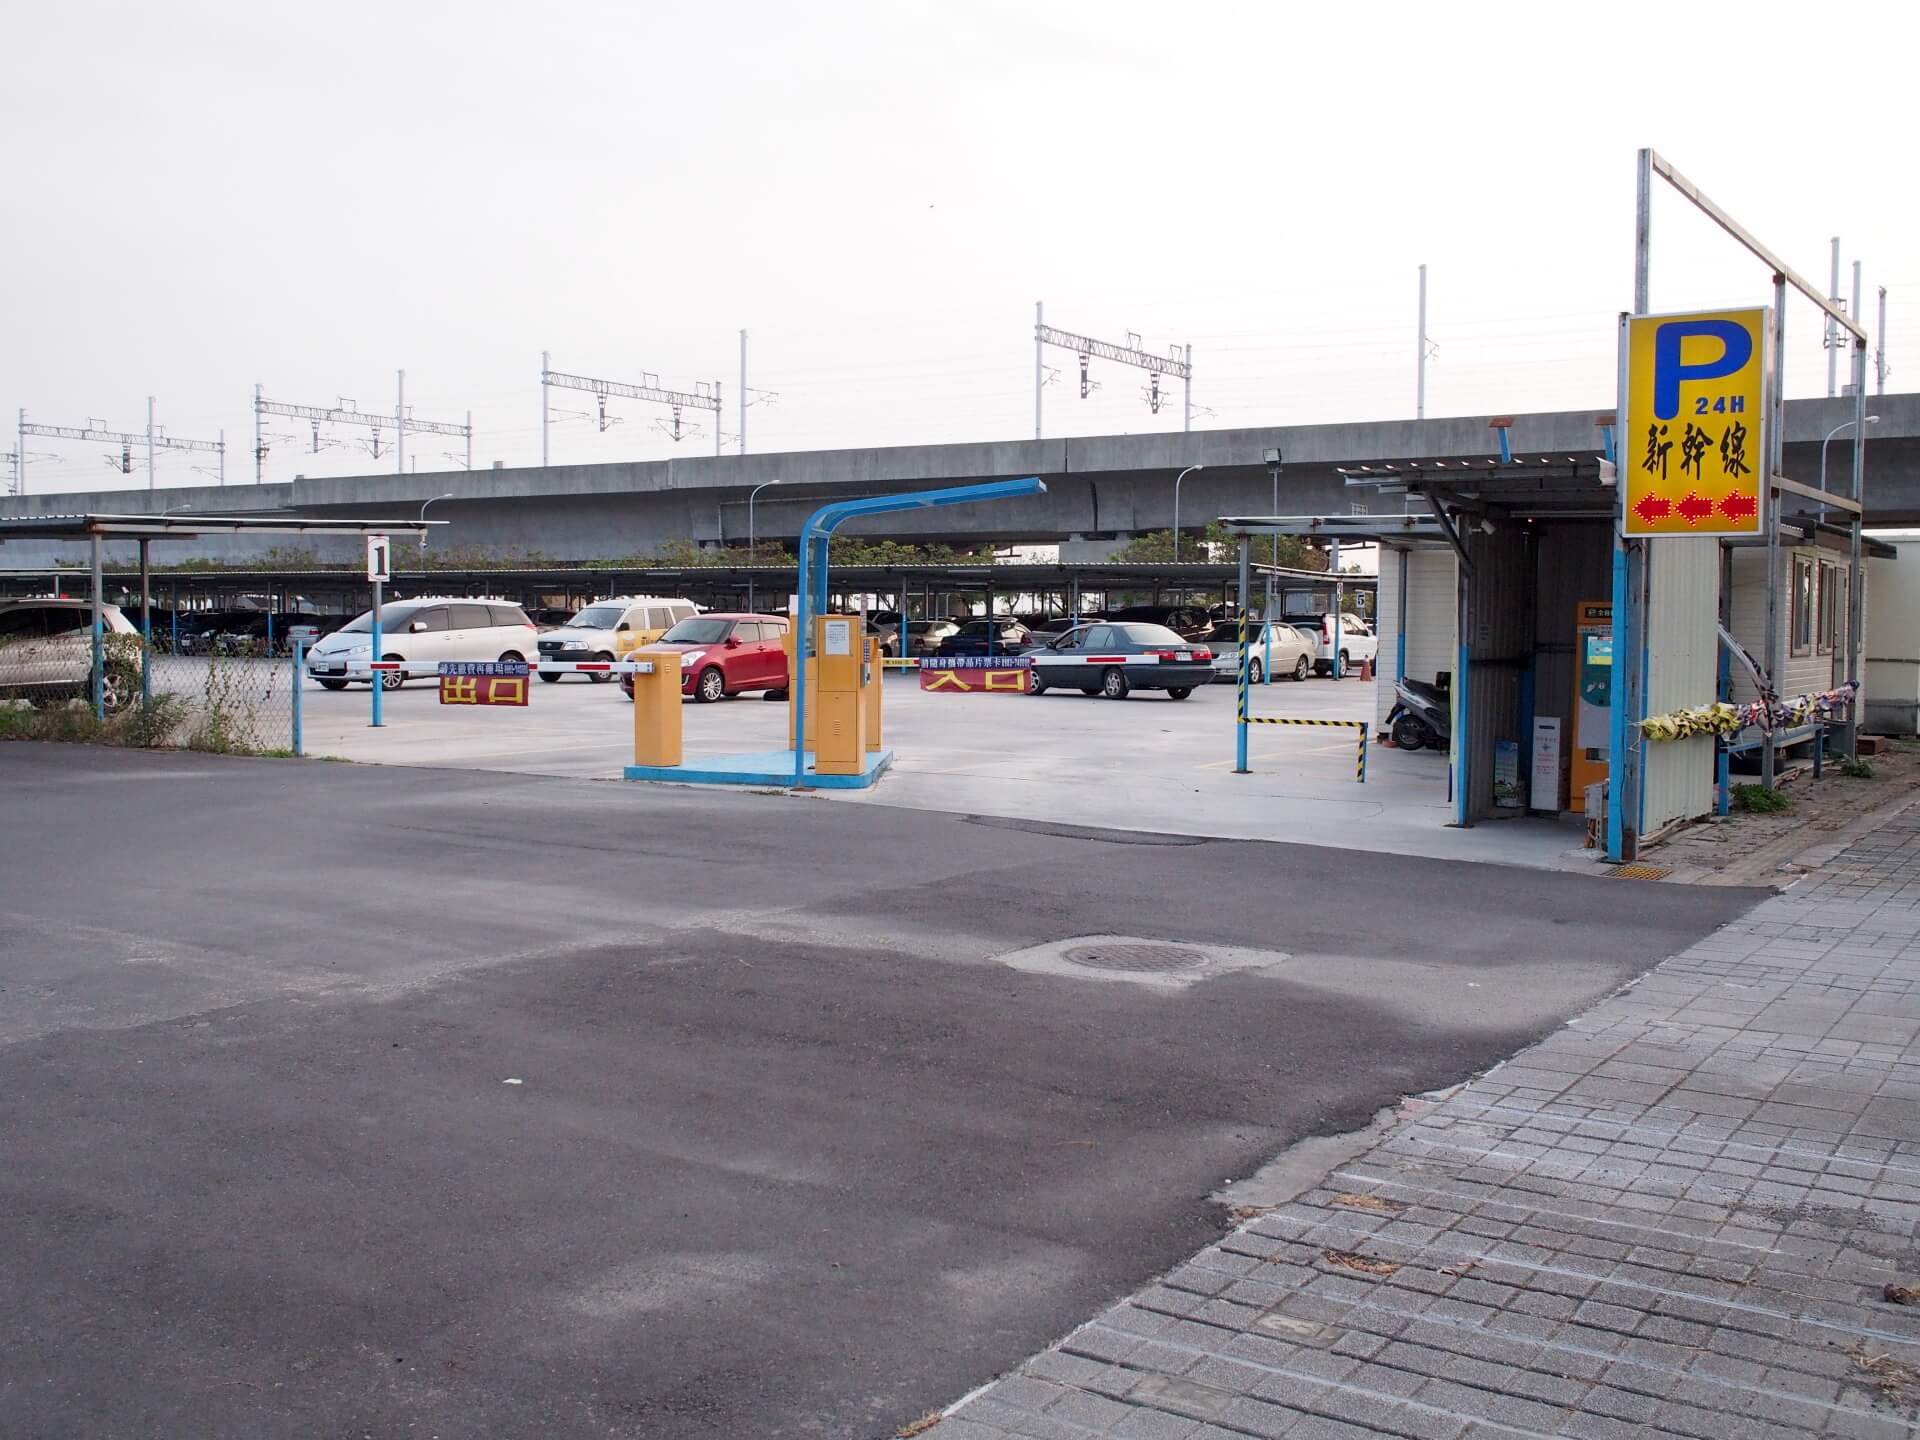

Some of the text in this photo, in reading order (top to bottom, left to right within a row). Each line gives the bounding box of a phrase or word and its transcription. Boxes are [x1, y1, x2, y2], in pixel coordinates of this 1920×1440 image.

[1654, 320, 1752, 420] P
[1695, 396, 1744, 415] 24H
[1642, 421, 1751, 480] 新幹線
[374, 546, 388, 576] 1
[1358, 594, 1365, 605] 5
[443, 676, 523, 704] 出口
[926, 670, 1025, 692] 入口
